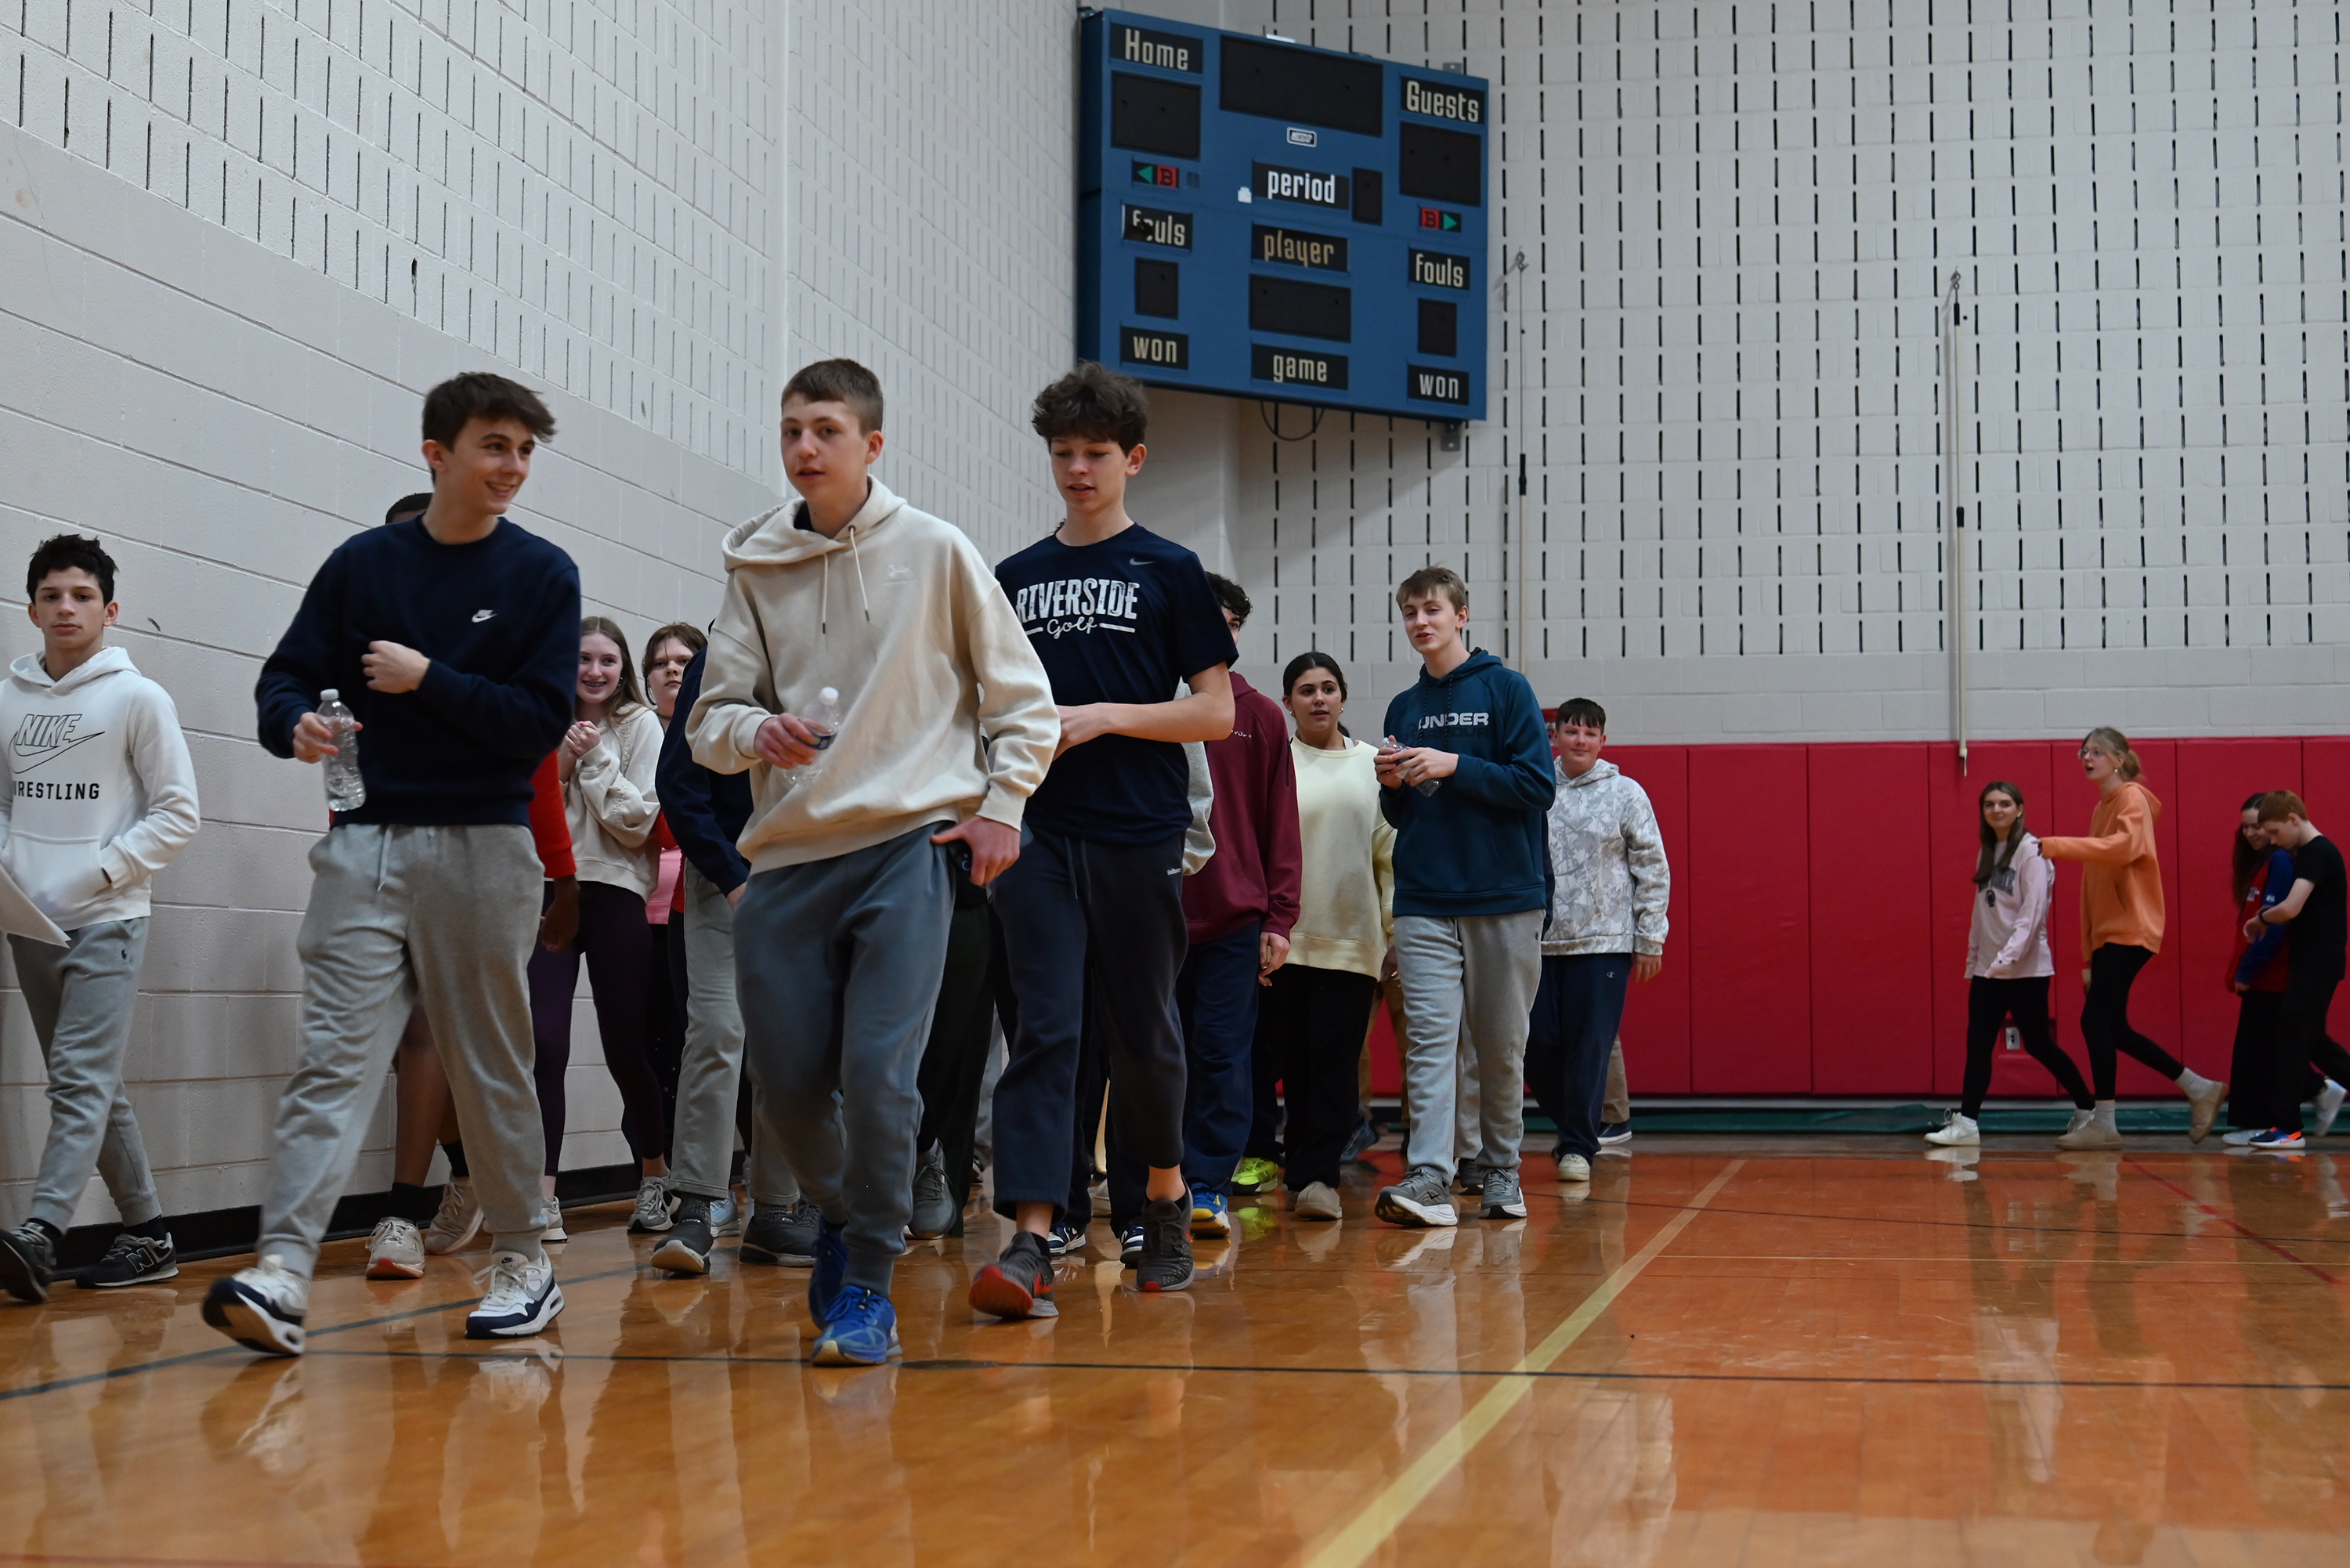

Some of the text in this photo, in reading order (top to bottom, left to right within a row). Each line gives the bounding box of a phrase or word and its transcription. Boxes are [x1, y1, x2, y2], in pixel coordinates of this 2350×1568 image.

[1125, 28, 1188, 71] Home
[1406, 81, 1479, 123] Guests
[1160, 168, 1173, 186] B
[1267, 170, 1336, 204] period
[1425, 211, 1437, 228] B
[1264, 230, 1334, 268] player
[1415, 253, 1463, 287] fouls
[1133, 336, 1177, 363] won
[1273, 355, 1327, 383] game
[1419, 373, 1459, 399] won
[1015, 577, 1141, 623] RIVERSIDE
[1047, 616, 1097, 639] Golf
[16, 714, 83, 747] NIKE
[1418, 712, 1489, 730] UNDER
